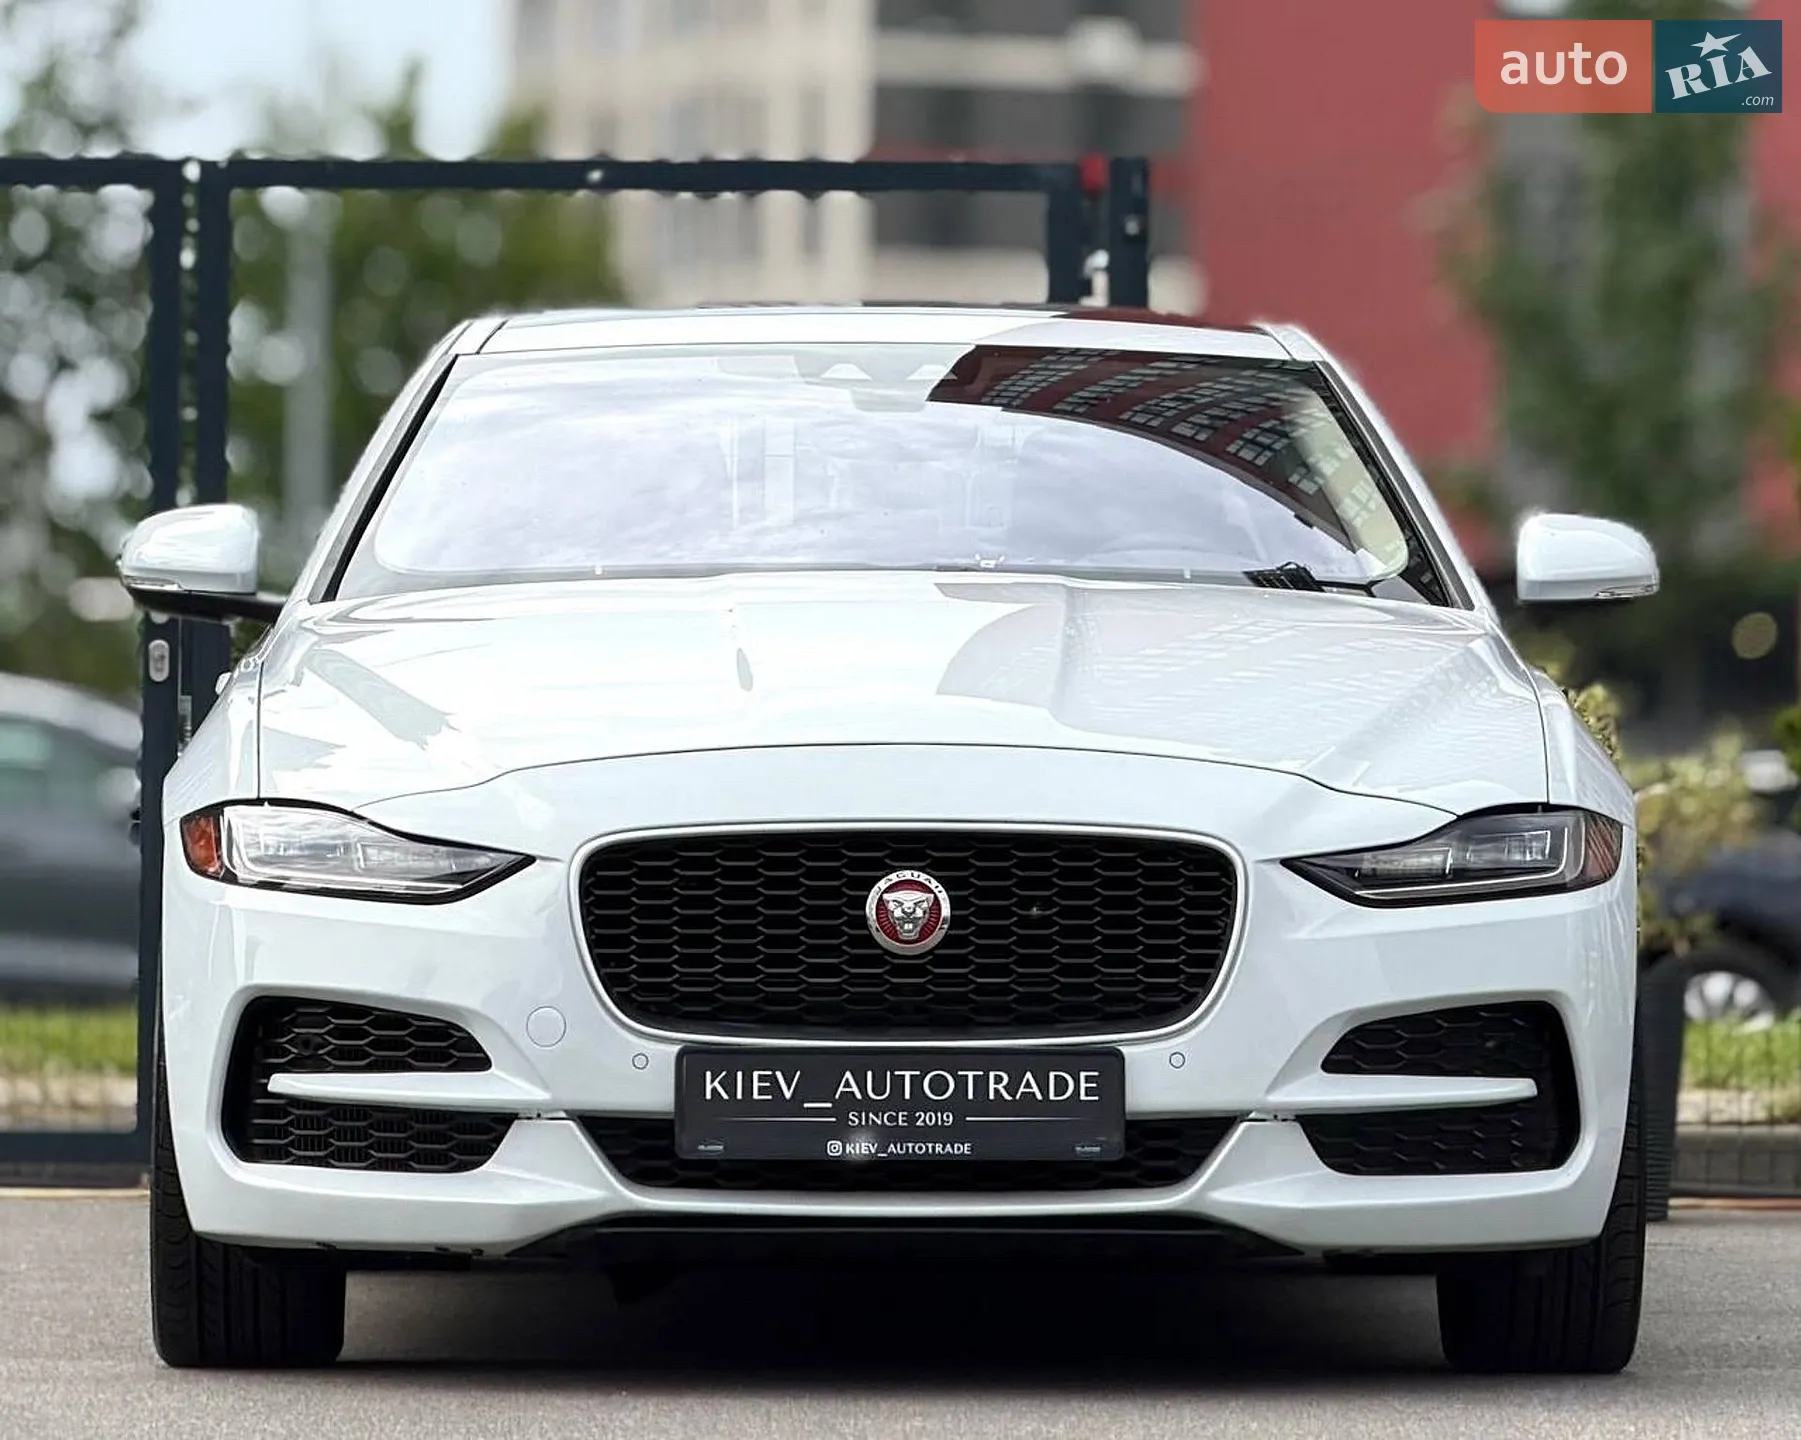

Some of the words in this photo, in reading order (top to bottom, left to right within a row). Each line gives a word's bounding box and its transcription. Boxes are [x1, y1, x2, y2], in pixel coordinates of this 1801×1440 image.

[704, 1070, 1099, 1108] KIEV_AUTOTRADE
[848, 1111, 908, 1126] SINCE
[915, 1111, 953, 1126] 2019
[846, 1142, 972, 1157] KIEV_AUTOTRADE
